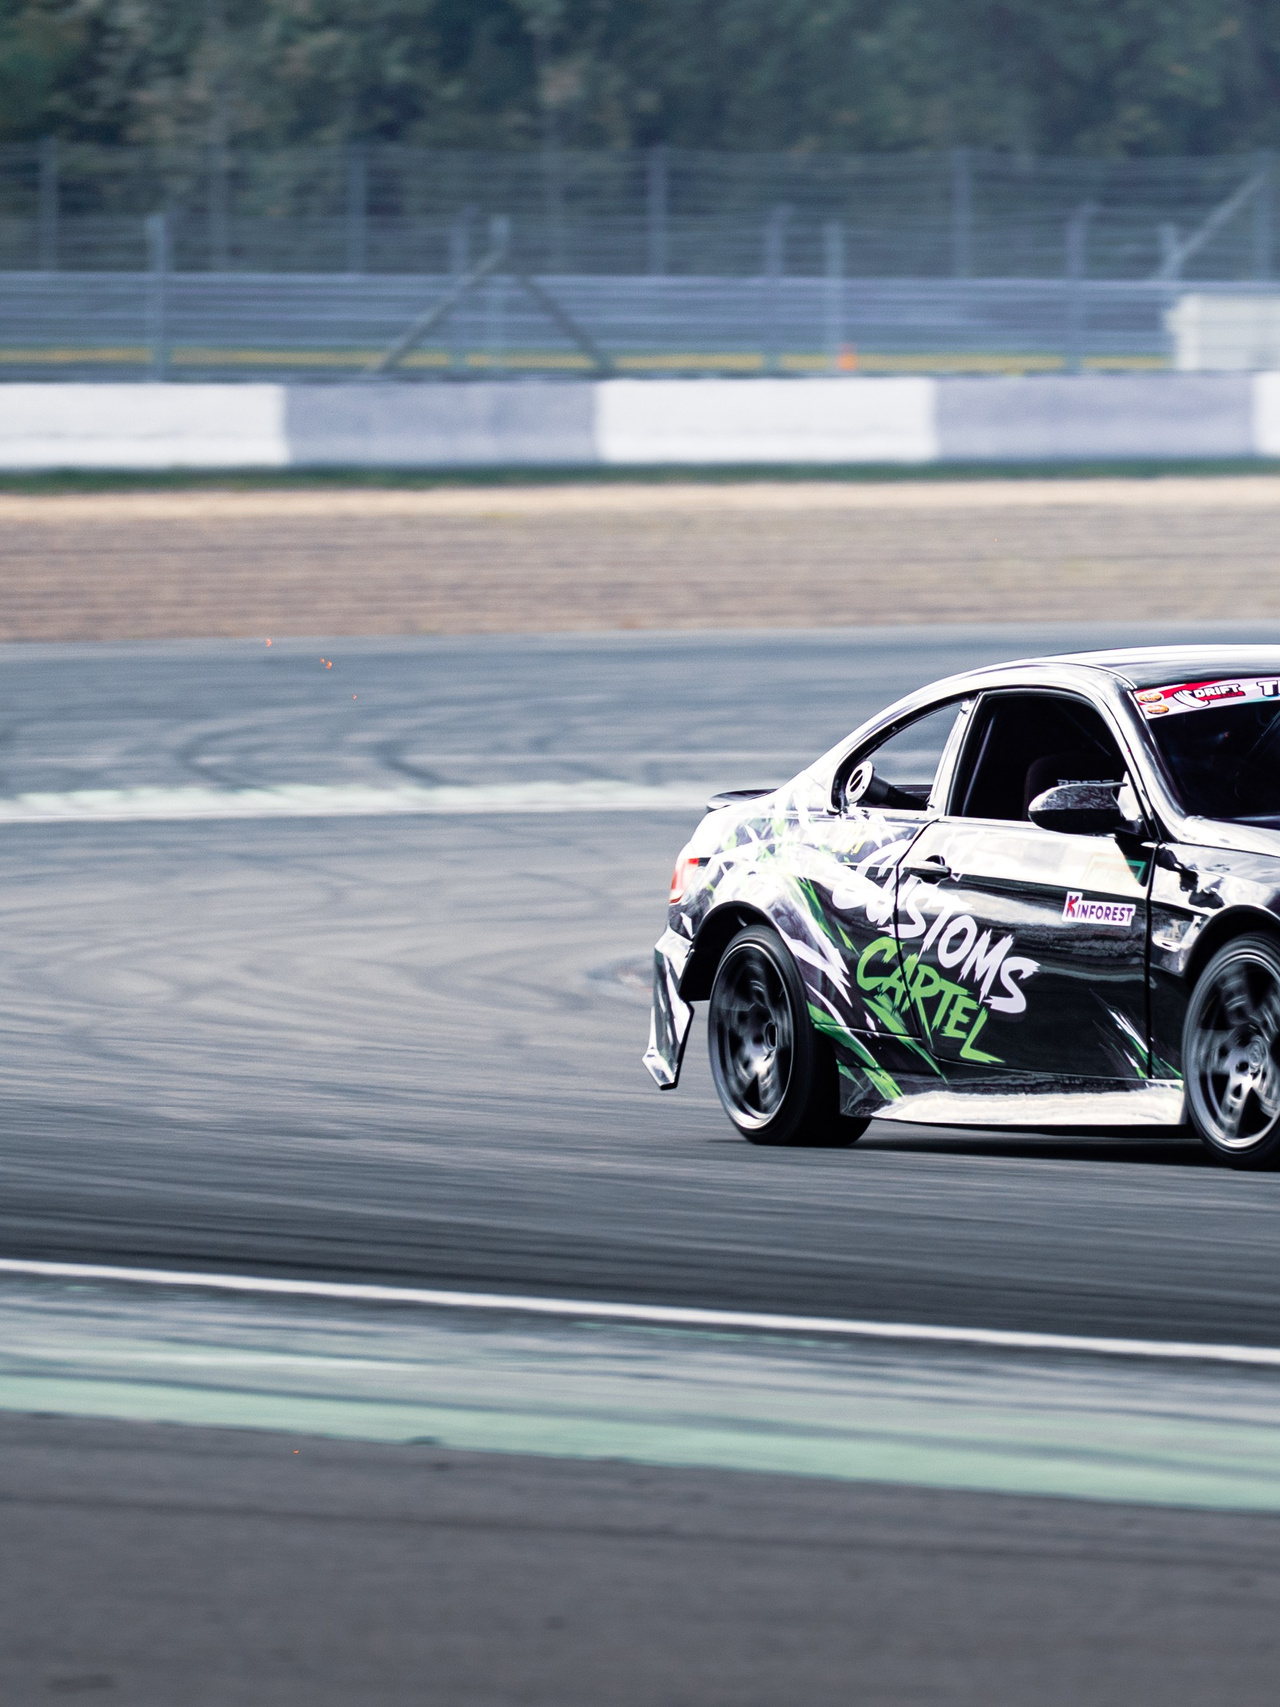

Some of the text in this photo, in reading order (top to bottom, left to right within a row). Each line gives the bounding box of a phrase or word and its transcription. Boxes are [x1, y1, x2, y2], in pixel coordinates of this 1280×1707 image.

[1193, 684, 1241, 698] DRIFT
[1066, 895, 1133, 922] KINFOREST
[857, 936, 1006, 1064] CARTEL
